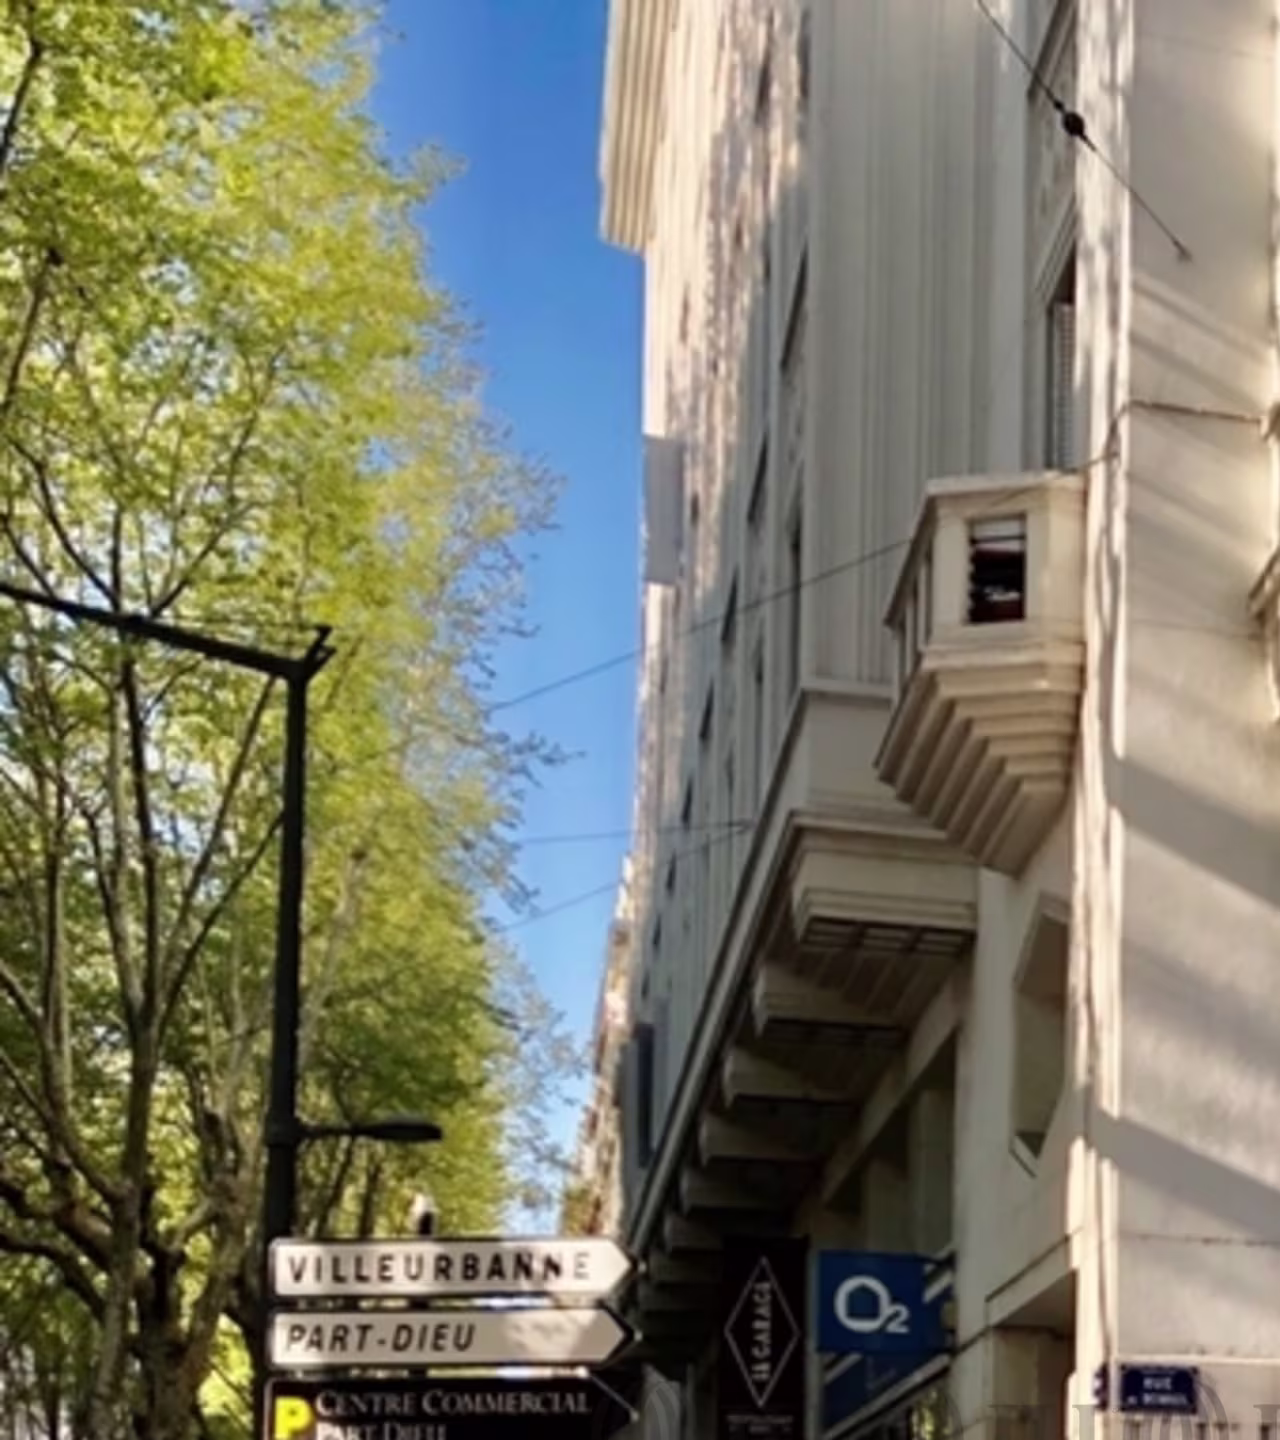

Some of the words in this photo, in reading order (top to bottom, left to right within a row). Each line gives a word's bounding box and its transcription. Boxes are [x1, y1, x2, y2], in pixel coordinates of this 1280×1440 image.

[288, 1251, 590, 1284] VILLEURBANNE
[287, 1323, 476, 1352] PART-DIEU
[316, 1390, 416, 1417] CENTRE
[421, 1389, 592, 1417] COMMERCIAL
